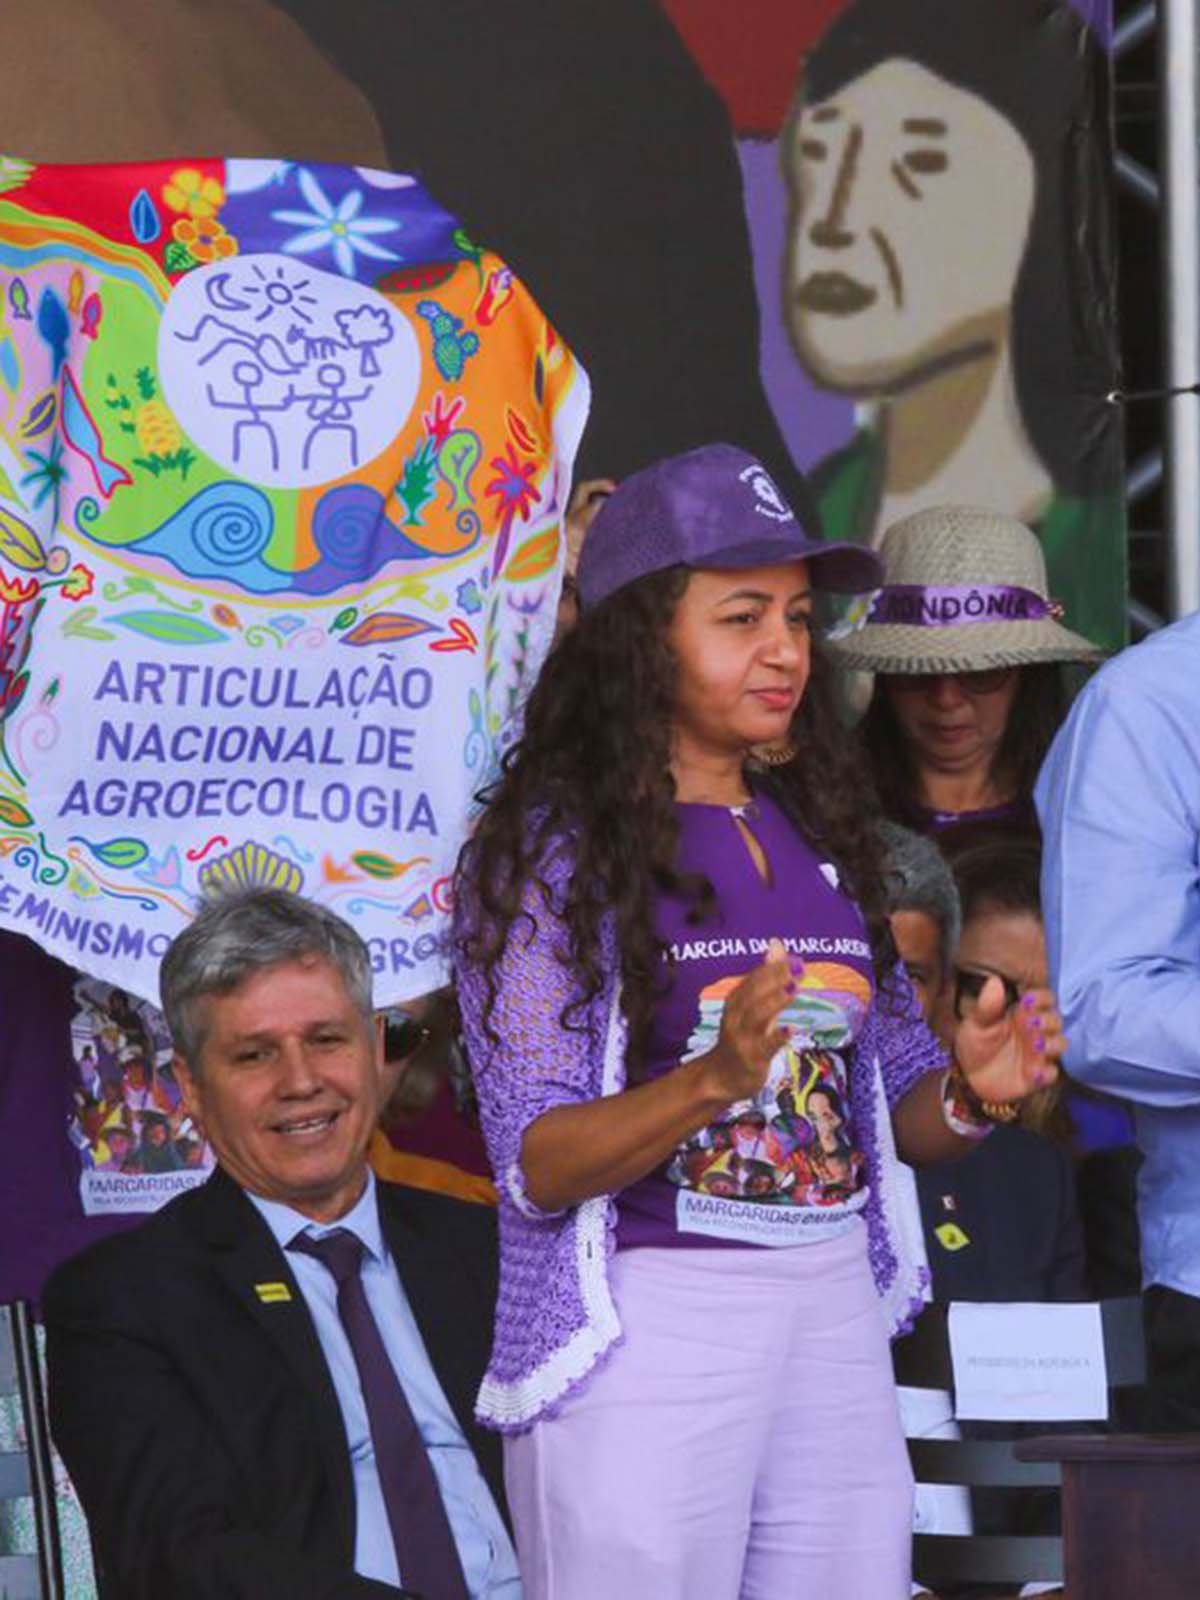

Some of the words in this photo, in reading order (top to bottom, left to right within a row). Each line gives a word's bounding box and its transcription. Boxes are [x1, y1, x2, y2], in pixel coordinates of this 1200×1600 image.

[94, 653, 433, 719] ARTICULAÇÃO
[96, 722, 344, 765] NACIONAL
[356, 724, 416, 770] DE
[59, 778, 438, 836] AGROECOLOGIA
[0, 873, 172, 961] EMINISMO
[685, 1199, 799, 1225] MARGARIDAS
